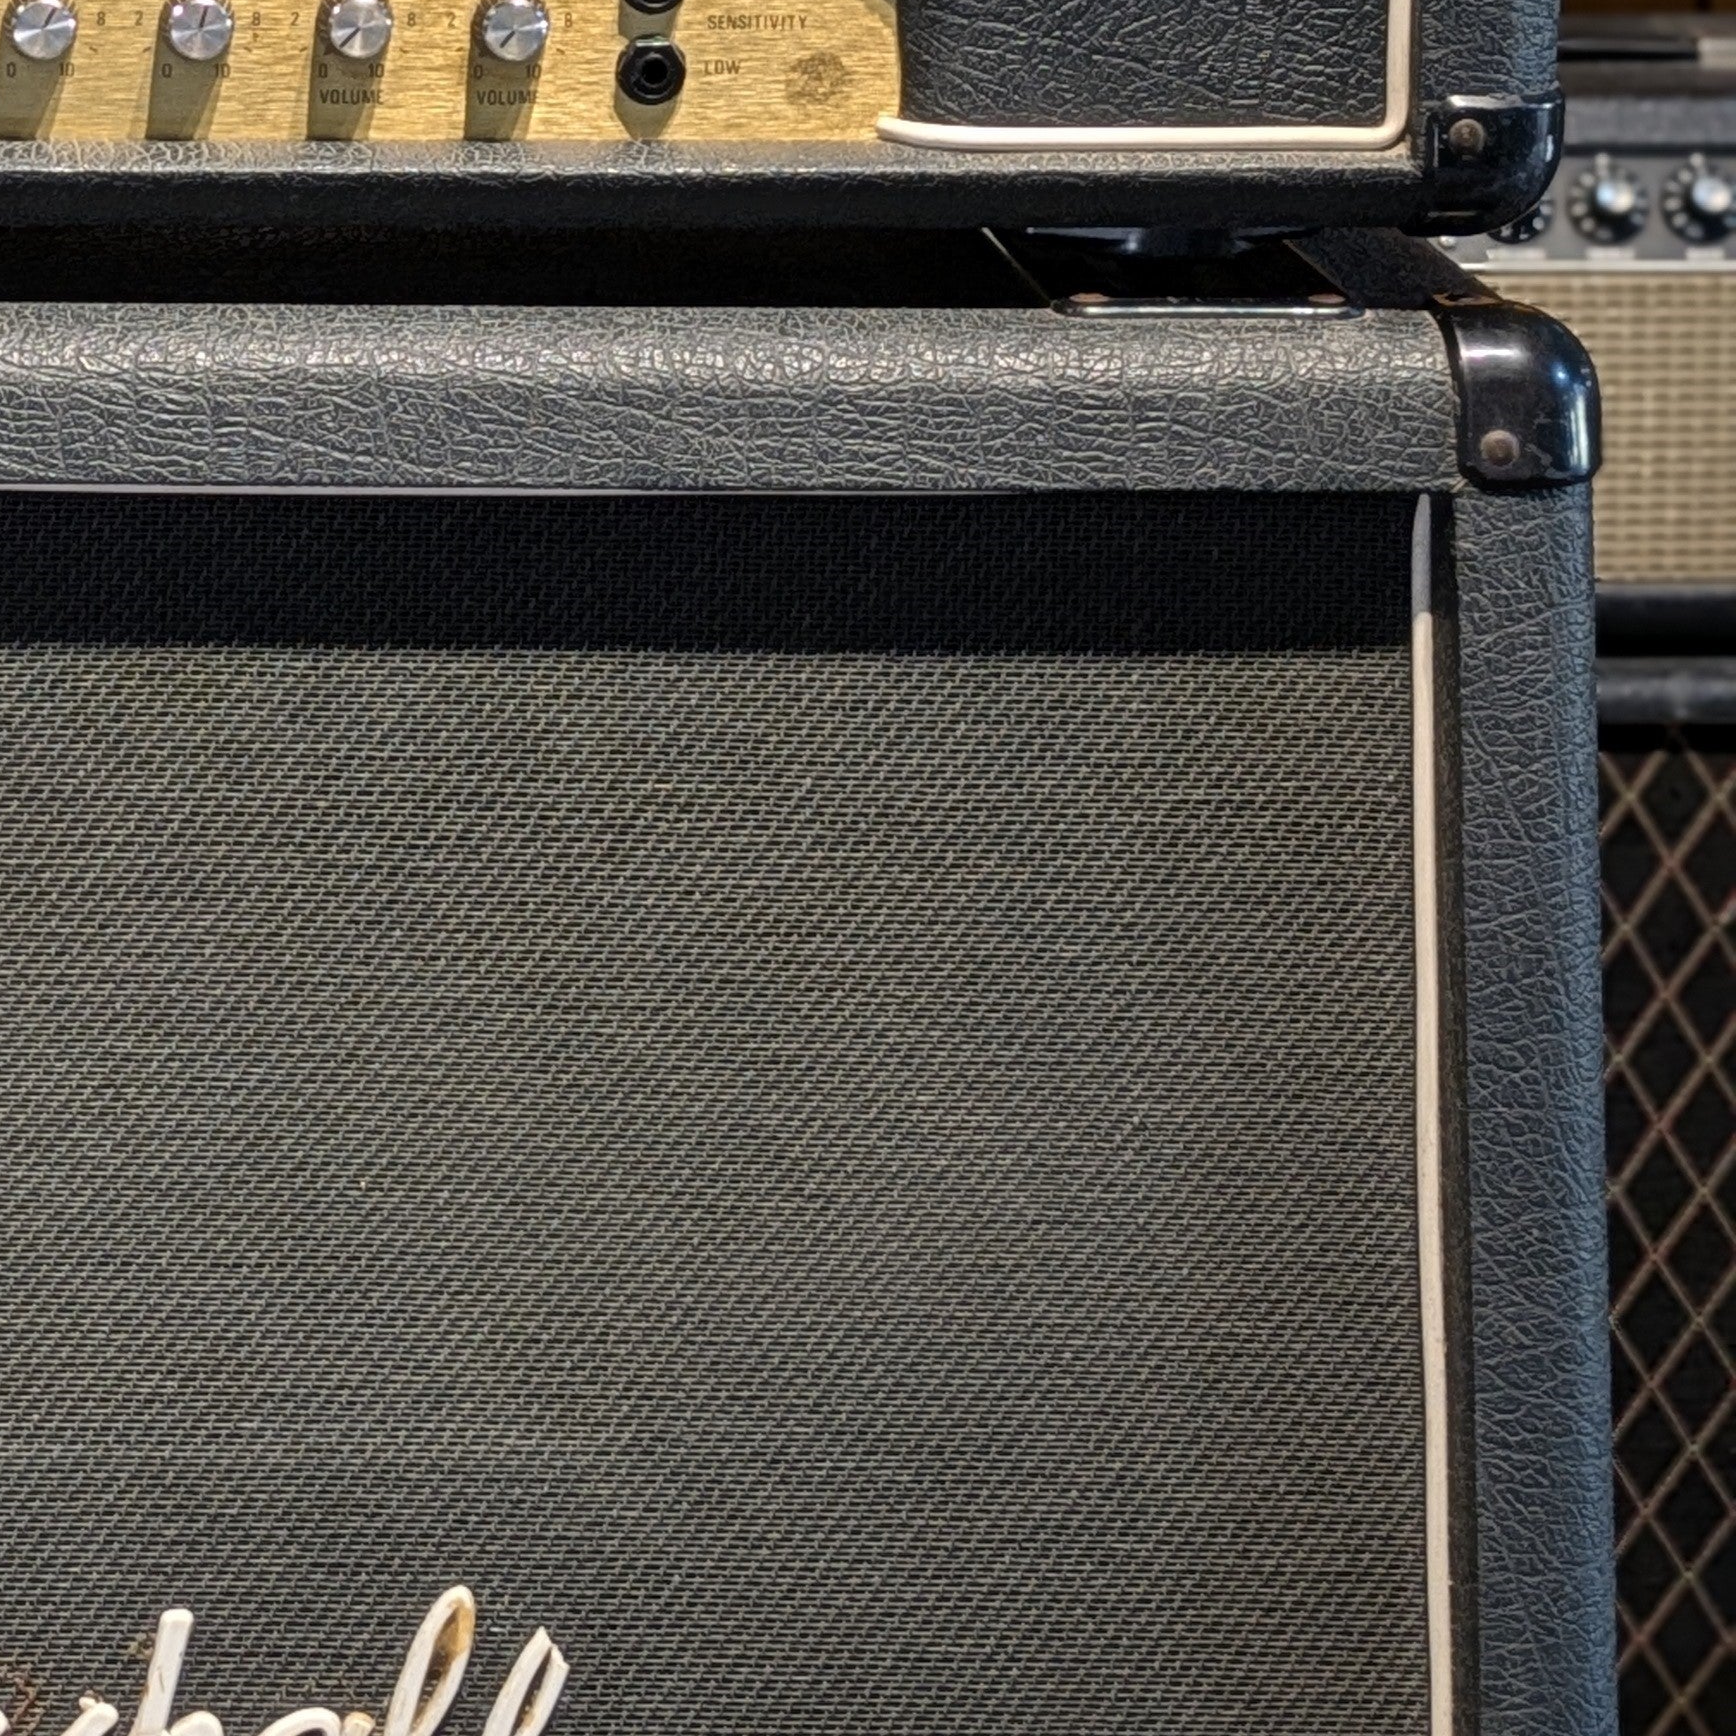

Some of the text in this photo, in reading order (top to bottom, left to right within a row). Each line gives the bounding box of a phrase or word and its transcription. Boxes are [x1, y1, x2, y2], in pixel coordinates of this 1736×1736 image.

[96, 11, 106, 26] 8
[134, 11, 143, 26] 2
[252, 11, 261, 26] 8
[290, 12, 299, 26] 2
[407, 12, 416, 27] 8
[447, 13, 456, 29] 2
[564, 12, 573, 28] 8
[707, 14, 807, 31] SENSITIVITY
[6, 62, 16, 78] 0
[60, 62, 75, 77] 10
[162, 63, 172, 78] 0
[215, 63, 231, 78] 10
[318, 63, 328, 78] 0
[368, 63, 384, 78] 10
[474, 65, 483, 79] 0
[526, 64, 542, 78] 10
[704, 60, 742, 75] LOW
[319, 89, 385, 105] VOLUME
[476, 90, 539, 106] VOLUME
